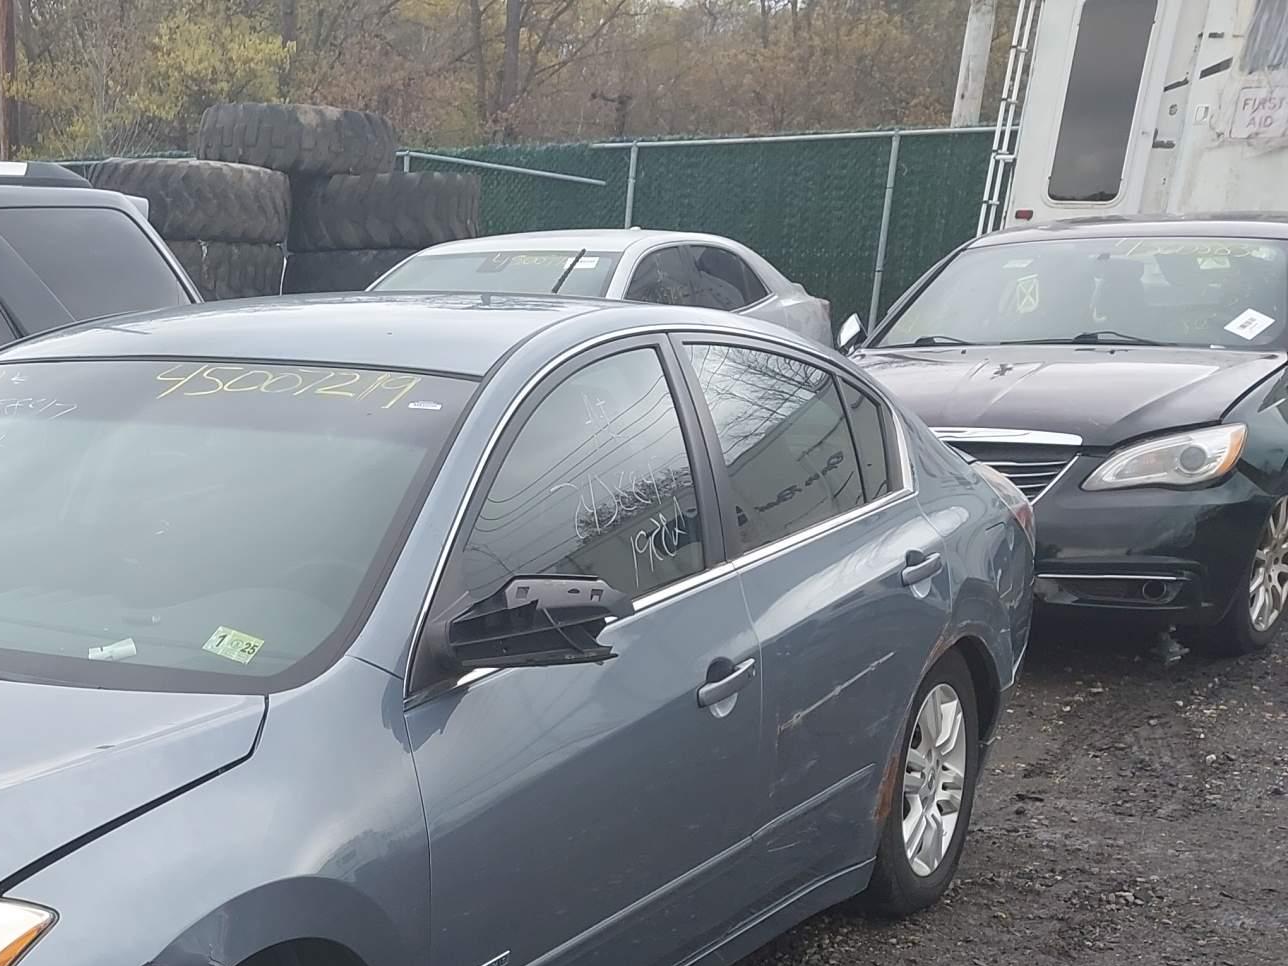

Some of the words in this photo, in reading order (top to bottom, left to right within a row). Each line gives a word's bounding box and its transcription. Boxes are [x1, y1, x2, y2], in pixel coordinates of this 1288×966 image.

[157, 364, 422, 409] 45007219
[216, 634, 228, 648] 1
[240, 642, 258, 655] 25
